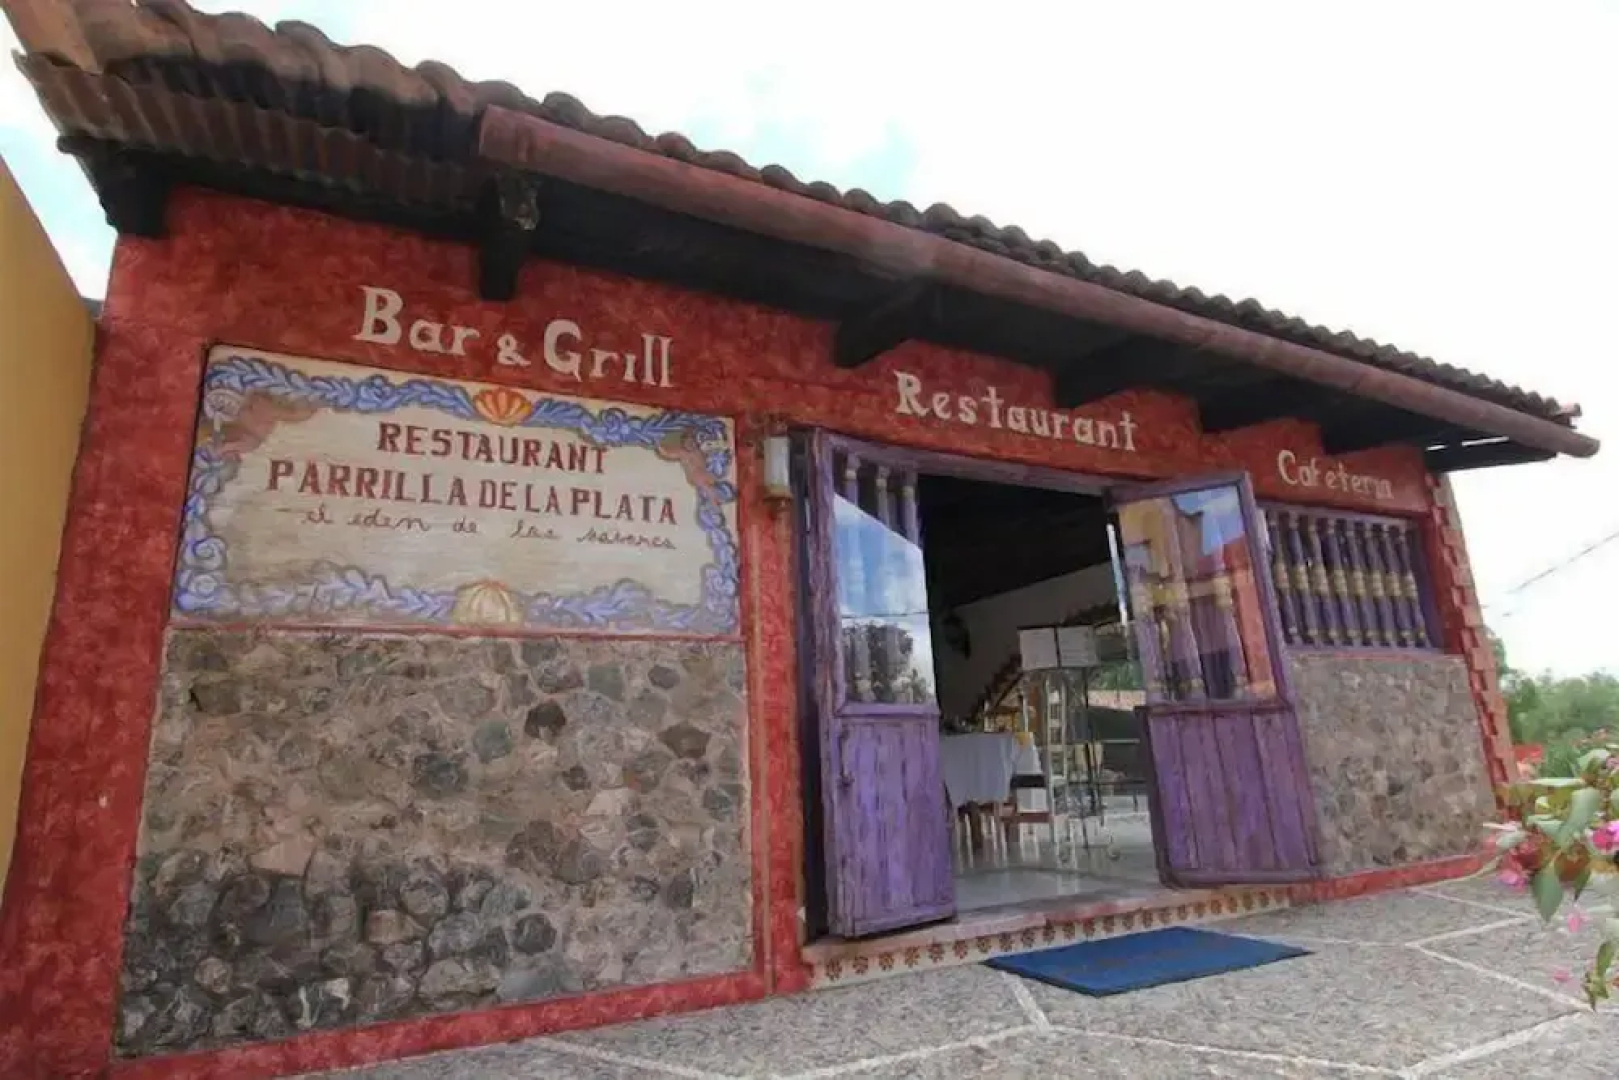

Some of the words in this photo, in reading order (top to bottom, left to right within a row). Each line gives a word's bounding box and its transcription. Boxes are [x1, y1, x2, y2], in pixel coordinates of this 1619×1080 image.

[353, 284, 480, 356] Bar
[497, 333, 532, 367] &
[543, 318, 675, 388] Grill
[893, 369, 1138, 451] Restaurant
[376, 421, 610, 474] RESTAURANT
[265, 456, 468, 507] PARRILLA
[569, 487, 677, 526] PLATA
[452, 516, 478, 534] de
